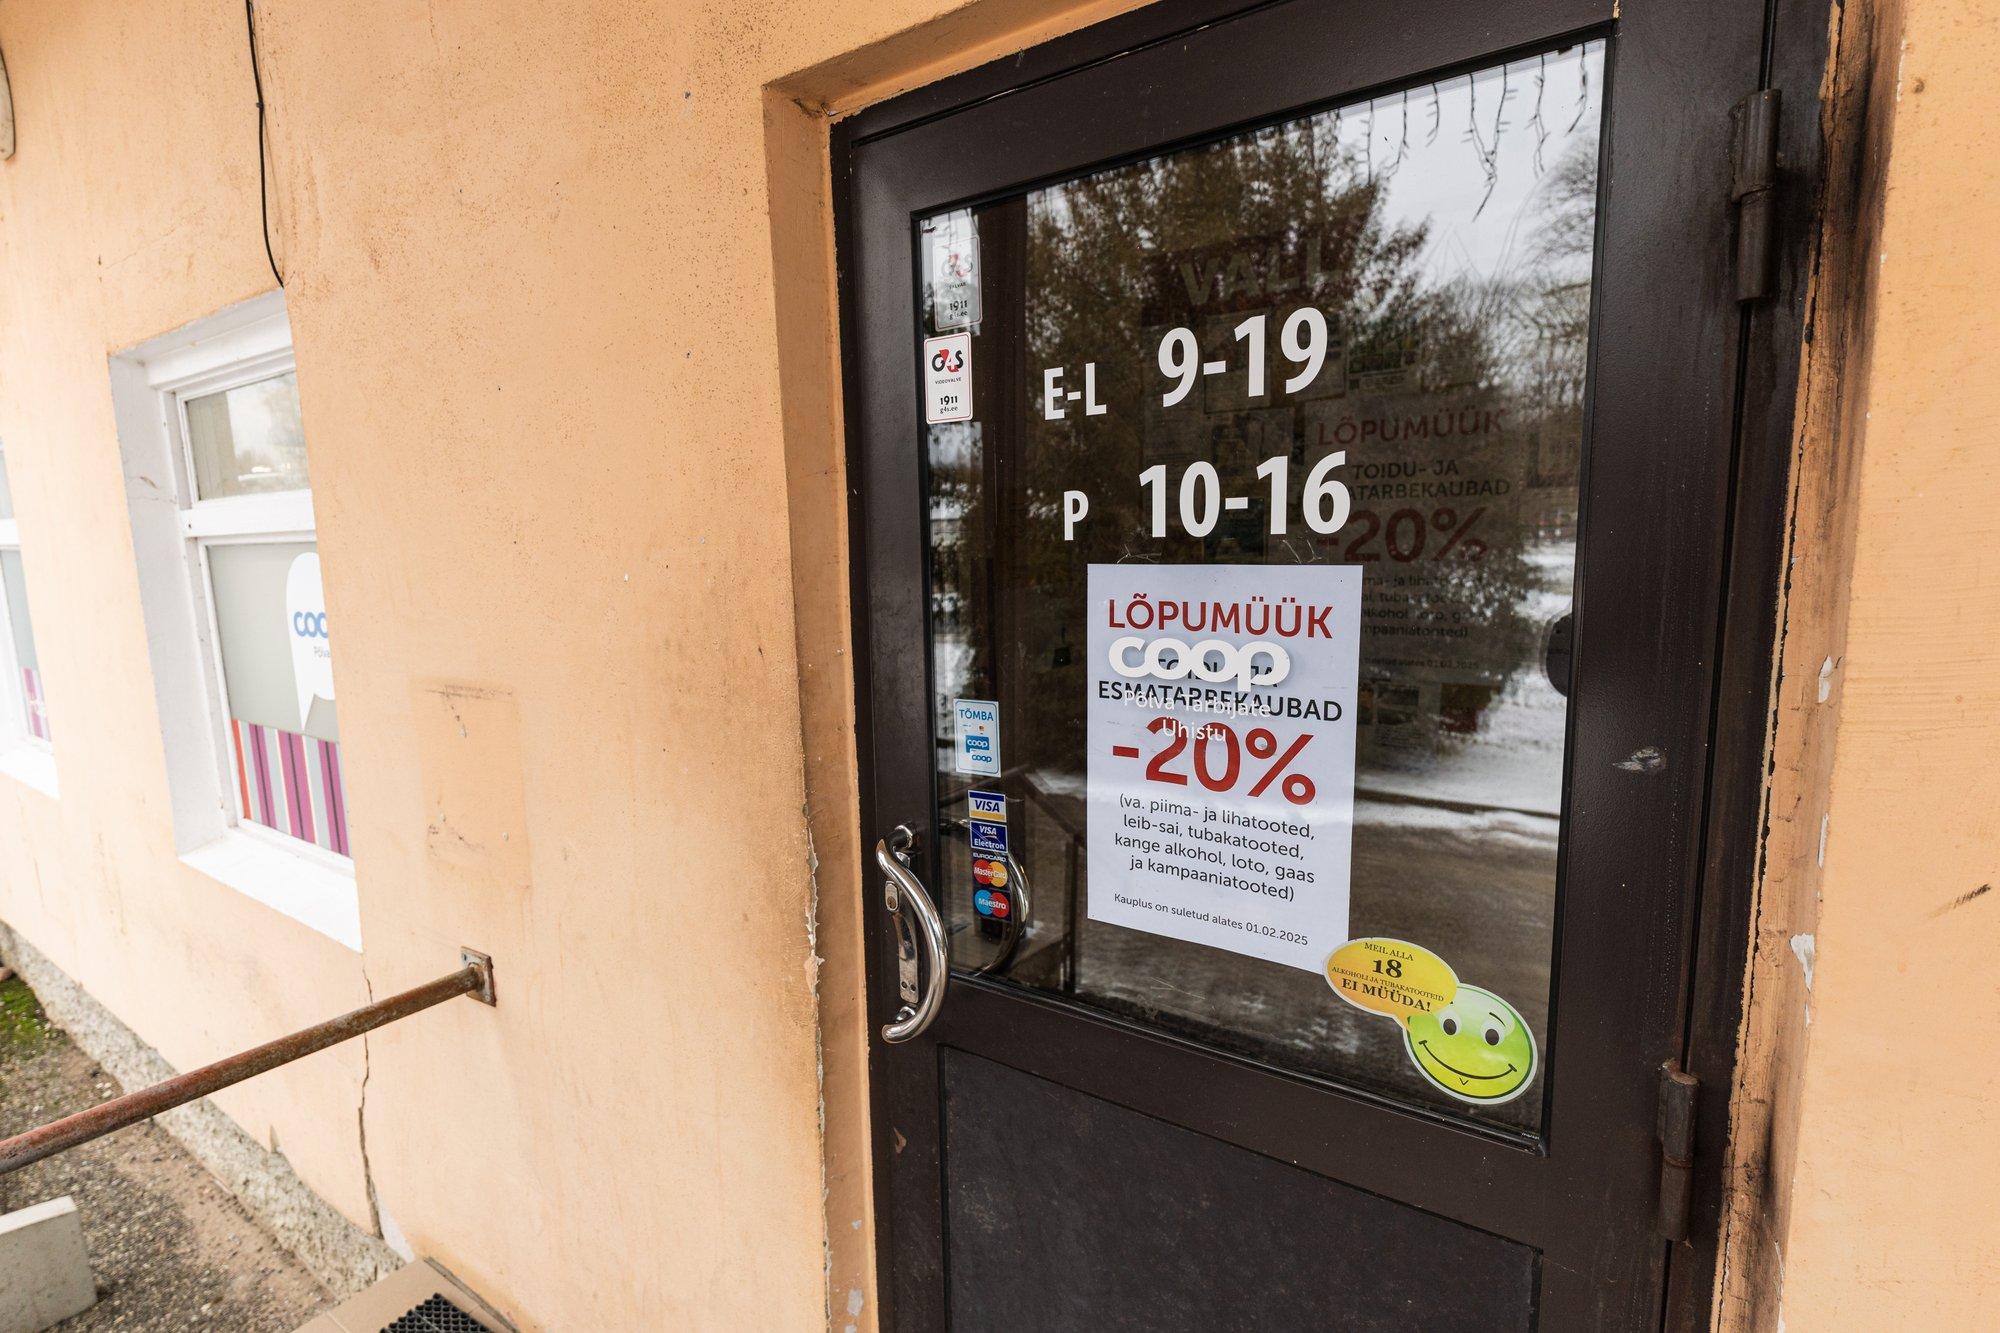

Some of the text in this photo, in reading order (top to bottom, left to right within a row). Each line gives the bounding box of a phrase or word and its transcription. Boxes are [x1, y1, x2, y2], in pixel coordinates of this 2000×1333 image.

[950, 300, 968, 311] 1911
[932, 348, 964, 372] G4S
[1158, 307, 1328, 407] 9-19
[940, 396, 958, 406] 1911
[940, 406, 958, 415] g4s.ee
[1433, 459, 1459, 476] JA
[1064, 450, 1351, 540] P 10-16
[1108, 593, 1334, 639] LÕPUMÜÜK
[1108, 637, 1291, 692] coop
[1181, 694, 1271, 719] Tarbijate
[1162, 716, 1227, 742] Ühistu
[967, 739, 988, 748] coop
[972, 754, 992, 763] coop
[1112, 716, 1316, 806] -20%
[975, 800, 1000, 812] VISA
[1119, 793, 1315, 840] (va. piima- ja lihatooted,
[979, 825, 997, 835] VISA
[1123, 814, 1304, 860] leib-sai, tubakatooted,
[974, 838, 1005, 850] Electron
[1115, 833, 1315, 884] kange alkohol, loto, gaas
[974, 867, 1007, 879] MasterCard
[1129, 855, 1295, 902] ja kampaaniatooted)
[978, 897, 1007, 910] Maestro
[1114, 893, 1308, 946] Kauplus on suletud alates 01.02.2025
[1364, 942, 1414, 961] MEIL ALLA
[1373, 959, 1402, 978] 18
[1332, 966, 1444, 1002] ALKOHOLI JA TUBAKATOOTEID
[1342, 977, 1431, 1012] EI MÜÜDA!
